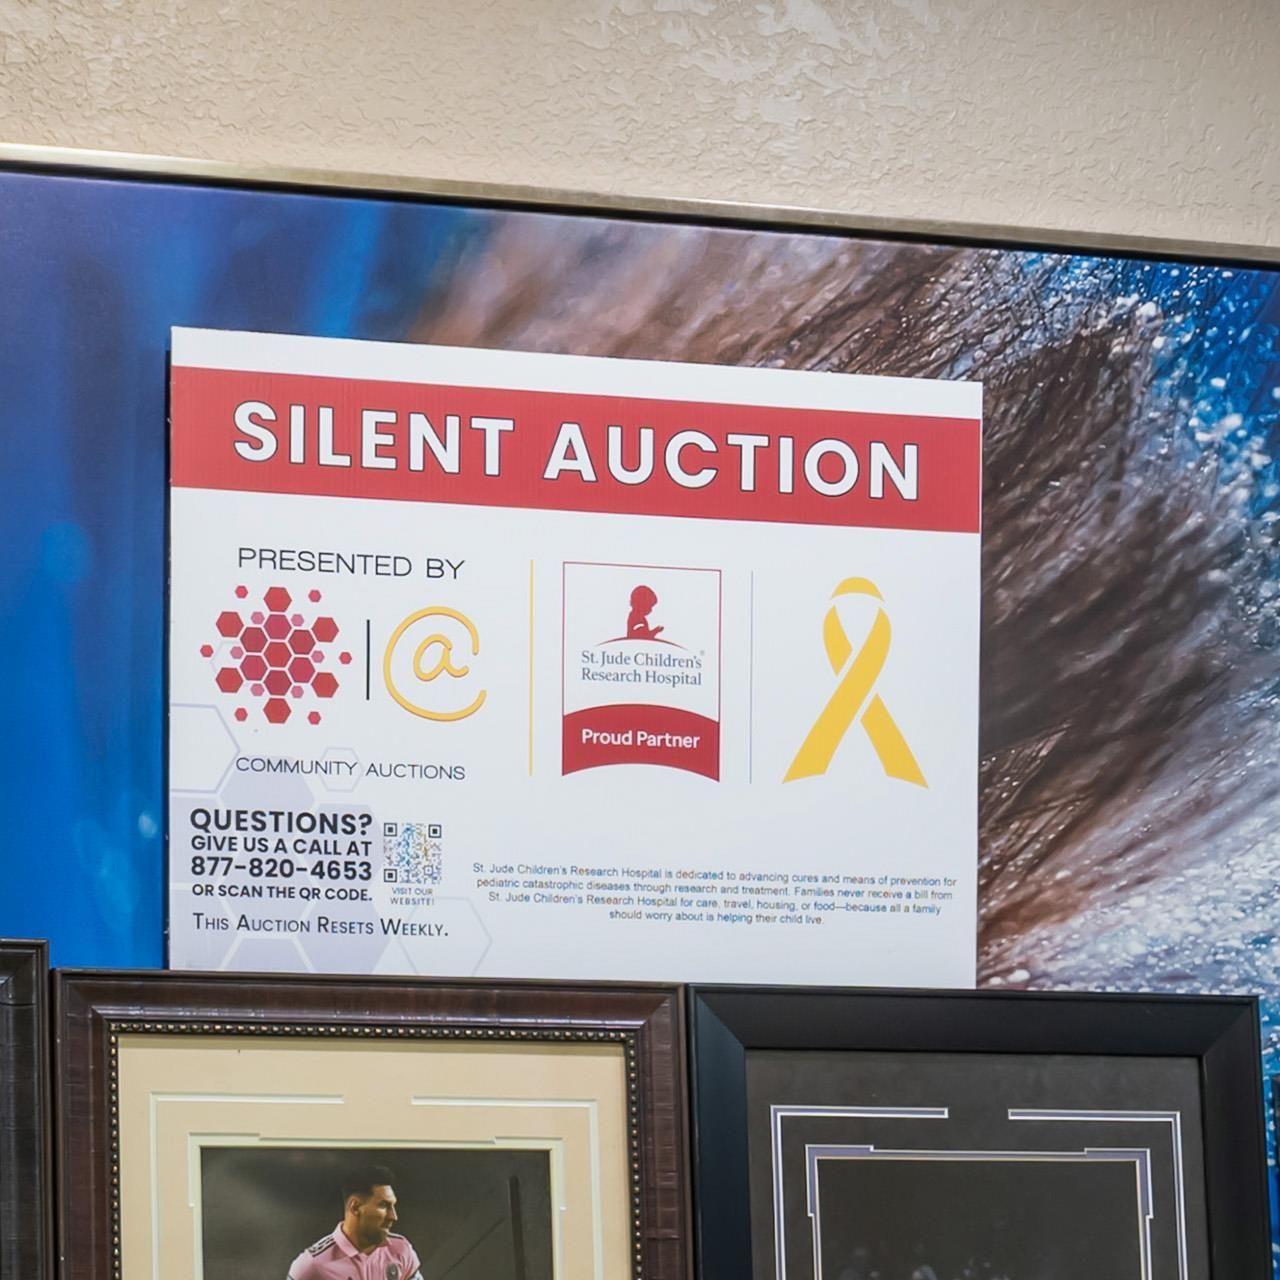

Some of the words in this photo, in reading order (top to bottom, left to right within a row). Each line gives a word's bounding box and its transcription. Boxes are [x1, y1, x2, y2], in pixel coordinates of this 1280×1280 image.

[232, 401, 514, 478] SILENT
[543, 423, 920, 502] AUCTION
[238, 547, 412, 579] PRESENTED
[426, 557, 465, 581] BY
[582, 650, 598, 664] St.
[601, 652, 631, 666] Jude
[634, 653, 702, 668] Children's
[582, 667, 641, 682] Research
[646, 670, 702, 688] Hospital
[582, 729, 632, 745] Proud
[637, 731, 700, 748] Partner
[235, 756, 357, 777] COMMUNITY
[365, 761, 466, 781] AUCTIONS
[190, 808, 372, 835] QUESTIONS?
[191, 835, 238, 851] GIVE
[243, 837, 269, 853] US
[274, 838, 288, 853] A
[293, 839, 342, 856] CALL
[346, 841, 372, 857] AT
[191, 856, 372, 881] 877-820-4653
[490, 864, 514, 874] Jude
[517, 864, 567, 875] Children's
[571, 866, 618, 877] Research
[622, 867, 662, 879] Hospital
[665, 869, 673, 879] is
[676, 869, 723, 880] dedicated
[726, 871, 736, 881] to
[739, 871, 789, 884] advancing
[792, 874, 818, 883] cures
[822, 874, 840, 884] and
[843, 876, 876, 885] means
[879, 875, 888, 885] of
[891, 876, 941, 887] prevention
[944, 877, 957, 887] for
[192, 884, 214, 896] OR
[218, 885, 263, 898] SCAN
[267, 886, 295, 899] THE
[299, 887, 321, 900] QR
[324, 888, 372, 901] CODE.
[392, 887, 412, 895] VISIT
[415, 888, 432, 896] OUR
[477, 878, 519, 889] pediatric
[522, 879, 583, 891] catastrophic
[587, 881, 630, 891] diseases
[634, 882, 672, 894] through
[675, 883, 718, 893] research
[720, 885, 738, 894] and
[794, 886, 835, 897] Families
[837, 888, 864, 897] never
[868, 888, 903, 898] receive
[906, 890, 912, 899] a
[914, 889, 929, 899] bill
[931, 890, 953, 900] from
[505, 893, 530, 903] Jude
[533, 893, 583, 905] Children's
[587, 895, 634, 906] Research
[638, 896, 678, 908] Hospital
[681, 898, 693, 907] for
[801, 902, 811, 911] or
[890, 903, 901, 912] all
[904, 905, 910, 913] a
[913, 903, 941, 915] family
[610, 910, 642, 920] should
[646, 911, 672, 922] worry
[676, 911, 703, 921] about
[706, 912, 714, 922] is
[717, 913, 752, 924] helping
[755, 914, 777, 923] their
[779, 915, 803, 924] child
